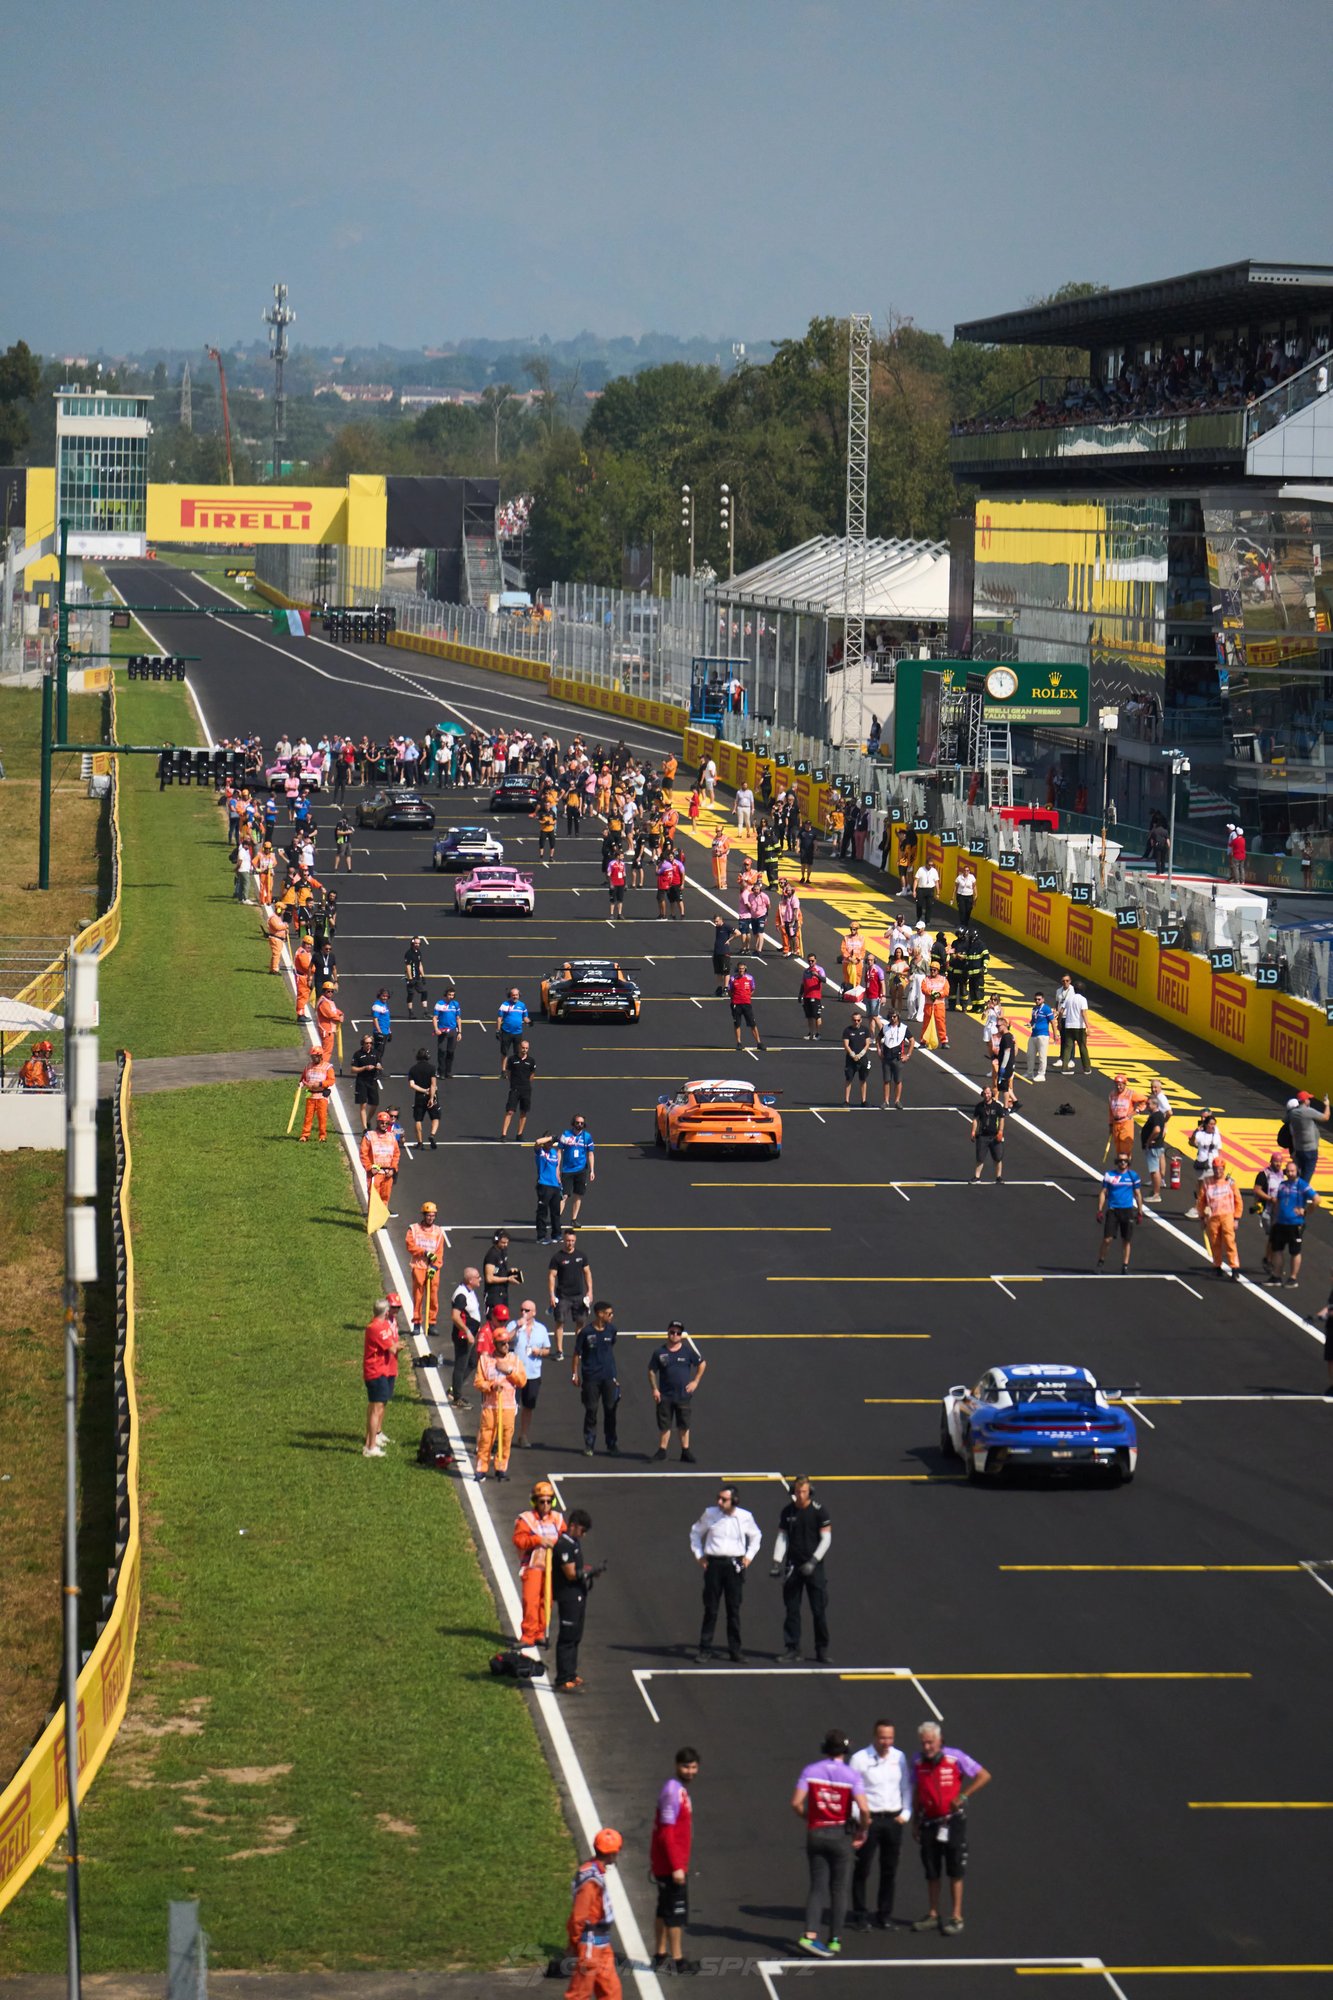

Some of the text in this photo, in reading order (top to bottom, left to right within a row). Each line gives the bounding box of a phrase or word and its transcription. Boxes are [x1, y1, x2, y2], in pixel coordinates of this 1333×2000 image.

[181, 499, 313, 530] PIRELLI
[1032, 688, 1078, 699] ROLEX
[1033, 708, 1061, 716] PREMIO
[745, 741, 751, 750] 1
[758, 747, 766, 756] 2
[778, 755, 785, 764] 3
[797, 763, 805, 772] 4
[815, 771, 823, 780] 5
[844, 785, 851, 795] 7
[865, 795, 873, 805] 8
[892, 809, 900, 820] 9
[913, 819, 928, 830] 10
[942, 831, 956, 843] 11
[970, 841, 984, 853] 12
[1000, 855, 1015, 867] 13
[1038, 875, 1056, 888] 14
[990, 871, 1013, 926] PIRELLI
[1073, 887, 1088, 900] 15
[1026, 888, 1051, 945] PIRELLI
[1118, 911, 1136, 925] 16
[1066, 906, 1093, 967] PIRELLI
[1160, 930, 1179, 945] 17
[1109, 926, 1139, 990] PIRELLI
[1212, 954, 1233, 968] 18
[1157, 949, 1190, 1016] PIRELLI
[1258, 968, 1278, 984] 19
[1210, 974, 1247, 1045] PIRELLI
[1269, 1000, 1310, 1077] PIRELLI
[101, 1623, 125, 1728] PIRELLI
